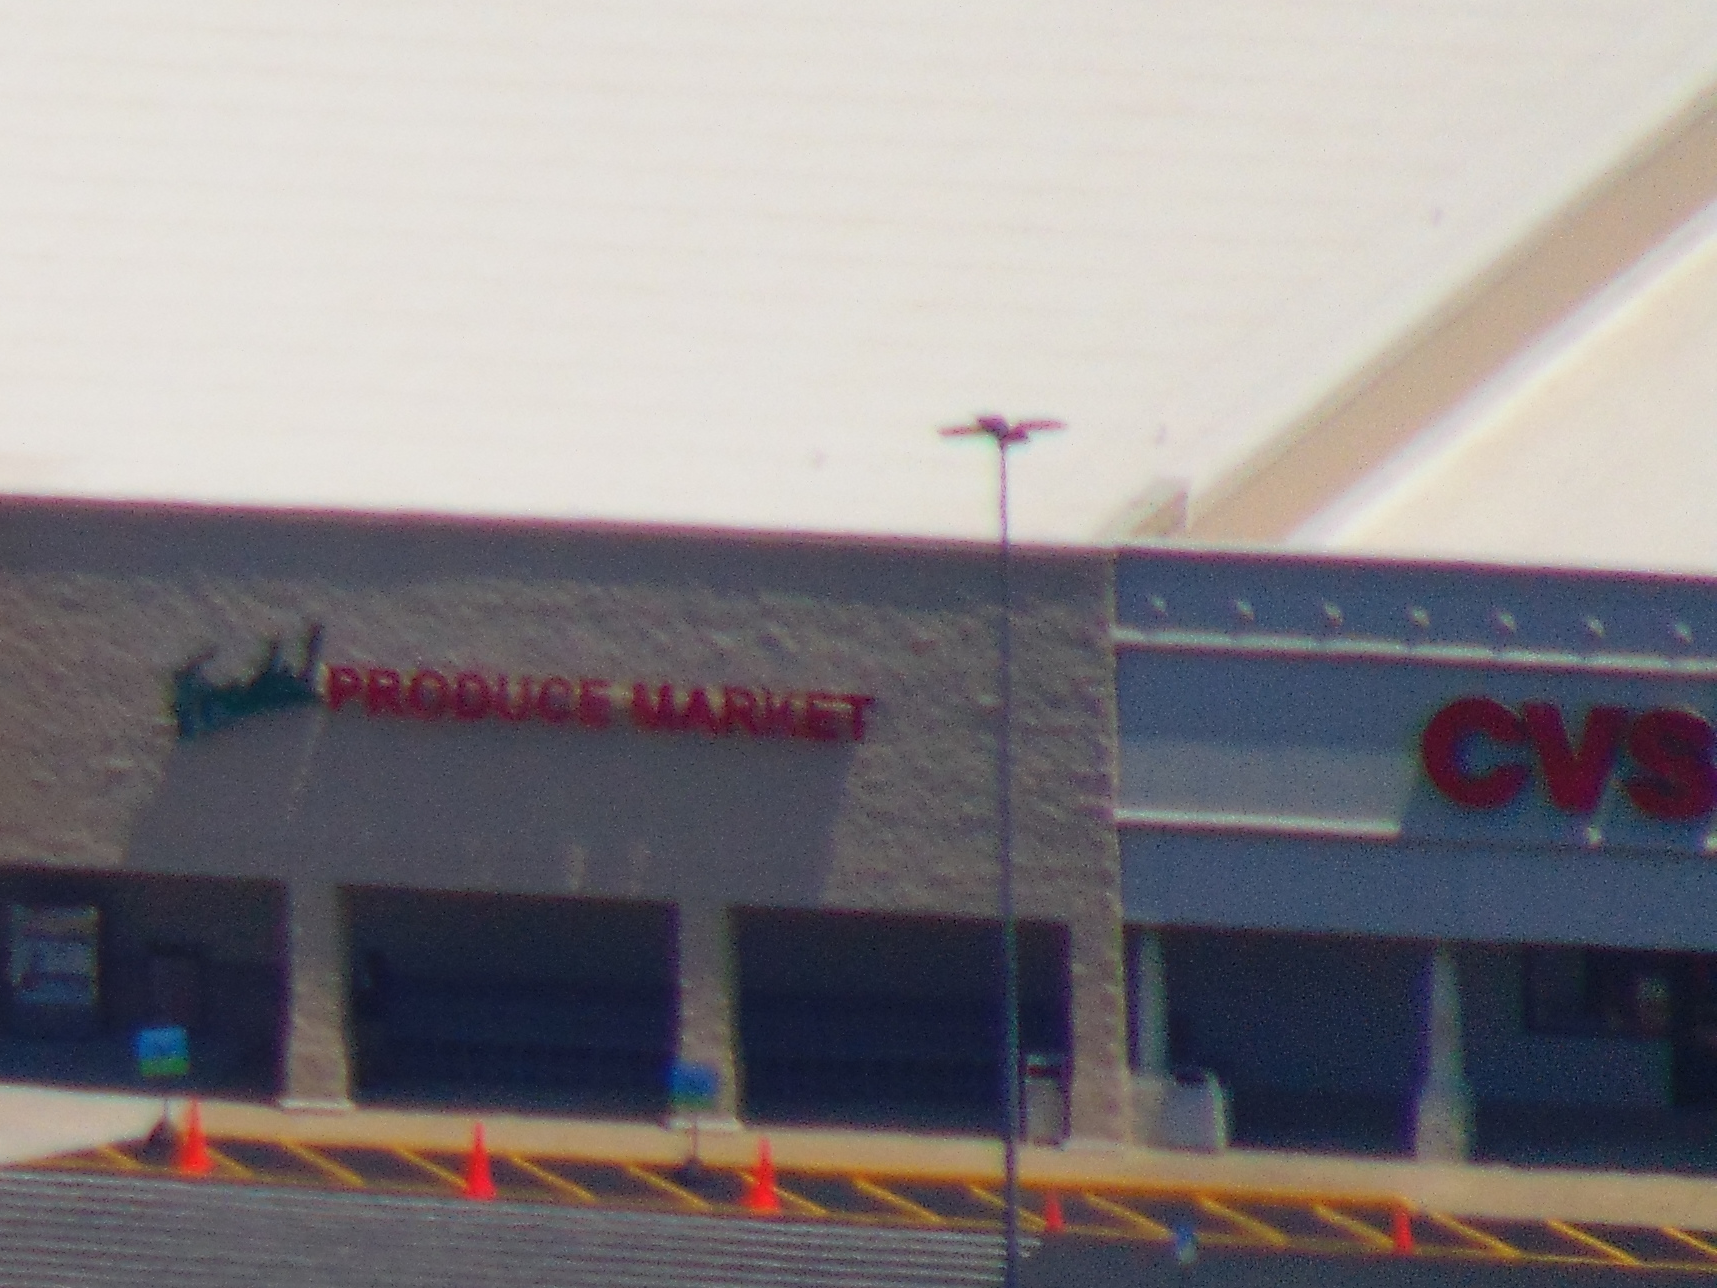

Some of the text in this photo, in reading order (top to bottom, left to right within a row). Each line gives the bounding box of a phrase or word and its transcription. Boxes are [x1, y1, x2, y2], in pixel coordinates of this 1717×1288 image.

[325, 664, 612, 731] PRODUCE
[631, 681, 875, 741] MARKET
[1422, 696, 1717, 822] CVS
